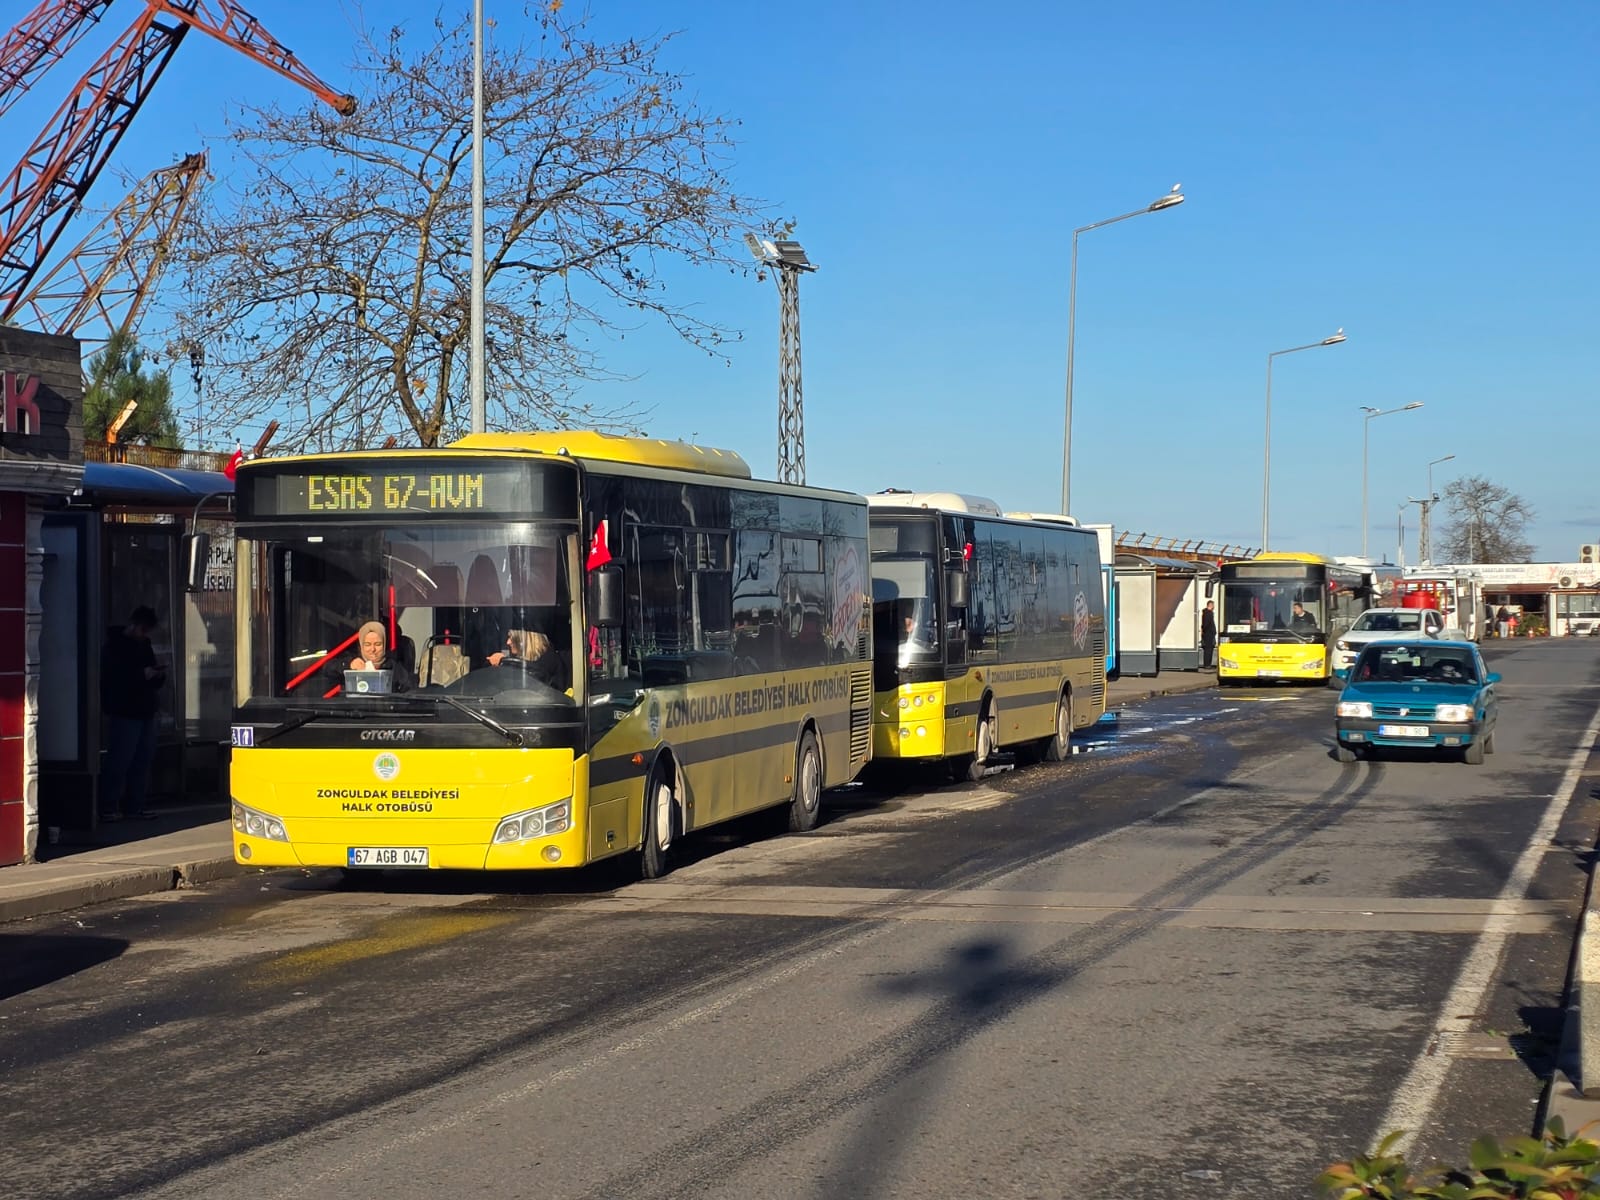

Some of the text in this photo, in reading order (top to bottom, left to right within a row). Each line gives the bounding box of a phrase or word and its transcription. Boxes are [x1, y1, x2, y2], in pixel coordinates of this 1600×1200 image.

[0, 369, 41, 435] K
[308, 473, 483, 510] ESAS 67-AVM
[665, 671, 849, 728] ZONGULDAK BELEDİYESİ HALK OTOBÜSÜ
[360, 729, 416, 741] OTOKAR
[316, 787, 460, 799] ZONGULDAK BELEDİYESİ
[341, 801, 433, 813] HALK OTOBÜSÜ
[355, 849, 370, 864] 67
[375, 850, 398, 864] AGB
[403, 850, 426, 864] 047
